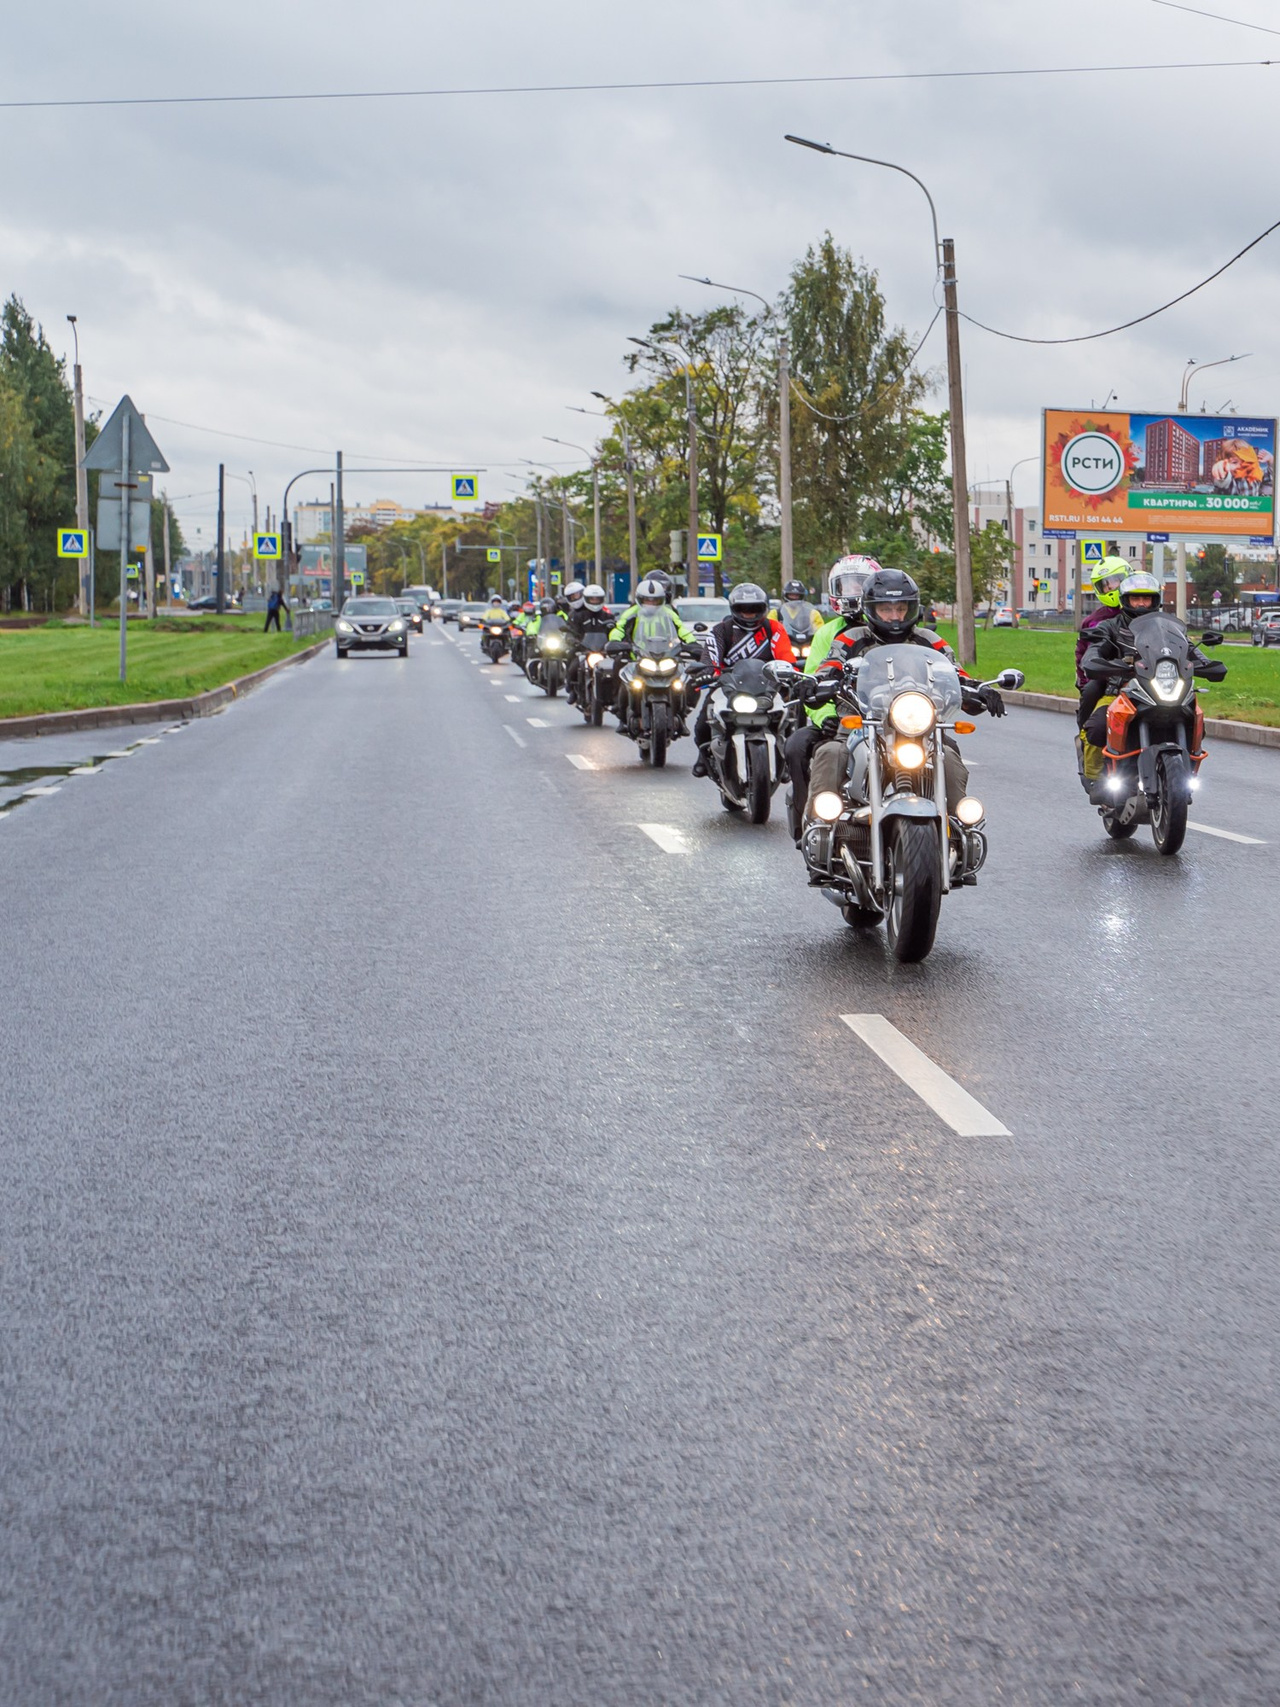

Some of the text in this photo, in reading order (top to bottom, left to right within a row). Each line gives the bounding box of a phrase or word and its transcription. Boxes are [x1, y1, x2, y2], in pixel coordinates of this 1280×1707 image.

[1072, 457, 1114, 470] РСТИ
[1143, 498, 1197, 508] КВАРТИРЫ
[1206, 497, 1222, 509] 30
[1223, 498, 1250, 510] 000
[1086, 515, 1100, 523] 561
[1101, 516, 1112, 524] 44
[1113, 516, 1124, 524] 44
